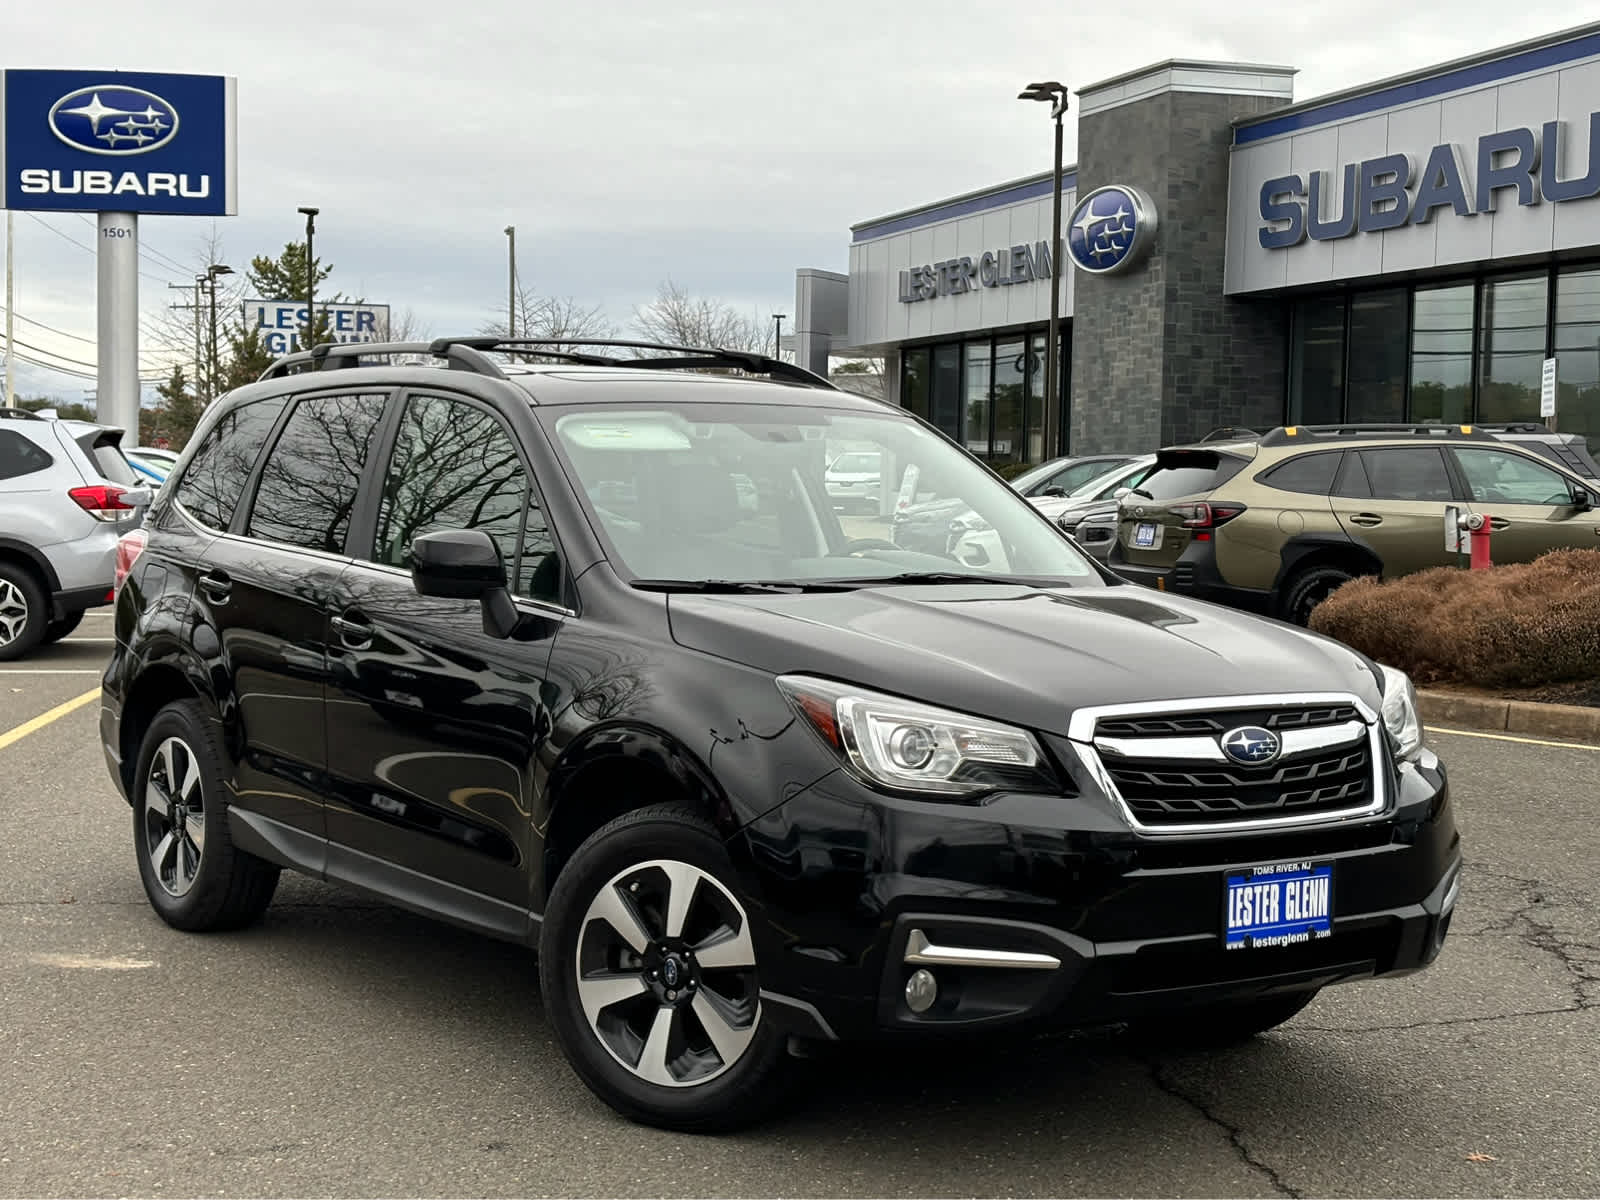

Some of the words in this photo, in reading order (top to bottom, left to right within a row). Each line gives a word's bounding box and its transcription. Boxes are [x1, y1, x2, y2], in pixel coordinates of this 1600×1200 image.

[20, 168, 210, 198] SUBARU
[1258, 111, 1600, 249] SUBARU
[103, 227, 132, 239] 1501
[899, 256, 972, 303] LESTER
[979, 240, 1053, 288] GLENN
[258, 307, 376, 332] LESTER
[1253, 867, 1275, 876] TOMS
[1301, 862, 1312, 870] NJ
[1228, 884, 1280, 928] LESTER
[1285, 878, 1329, 920] GLENN
